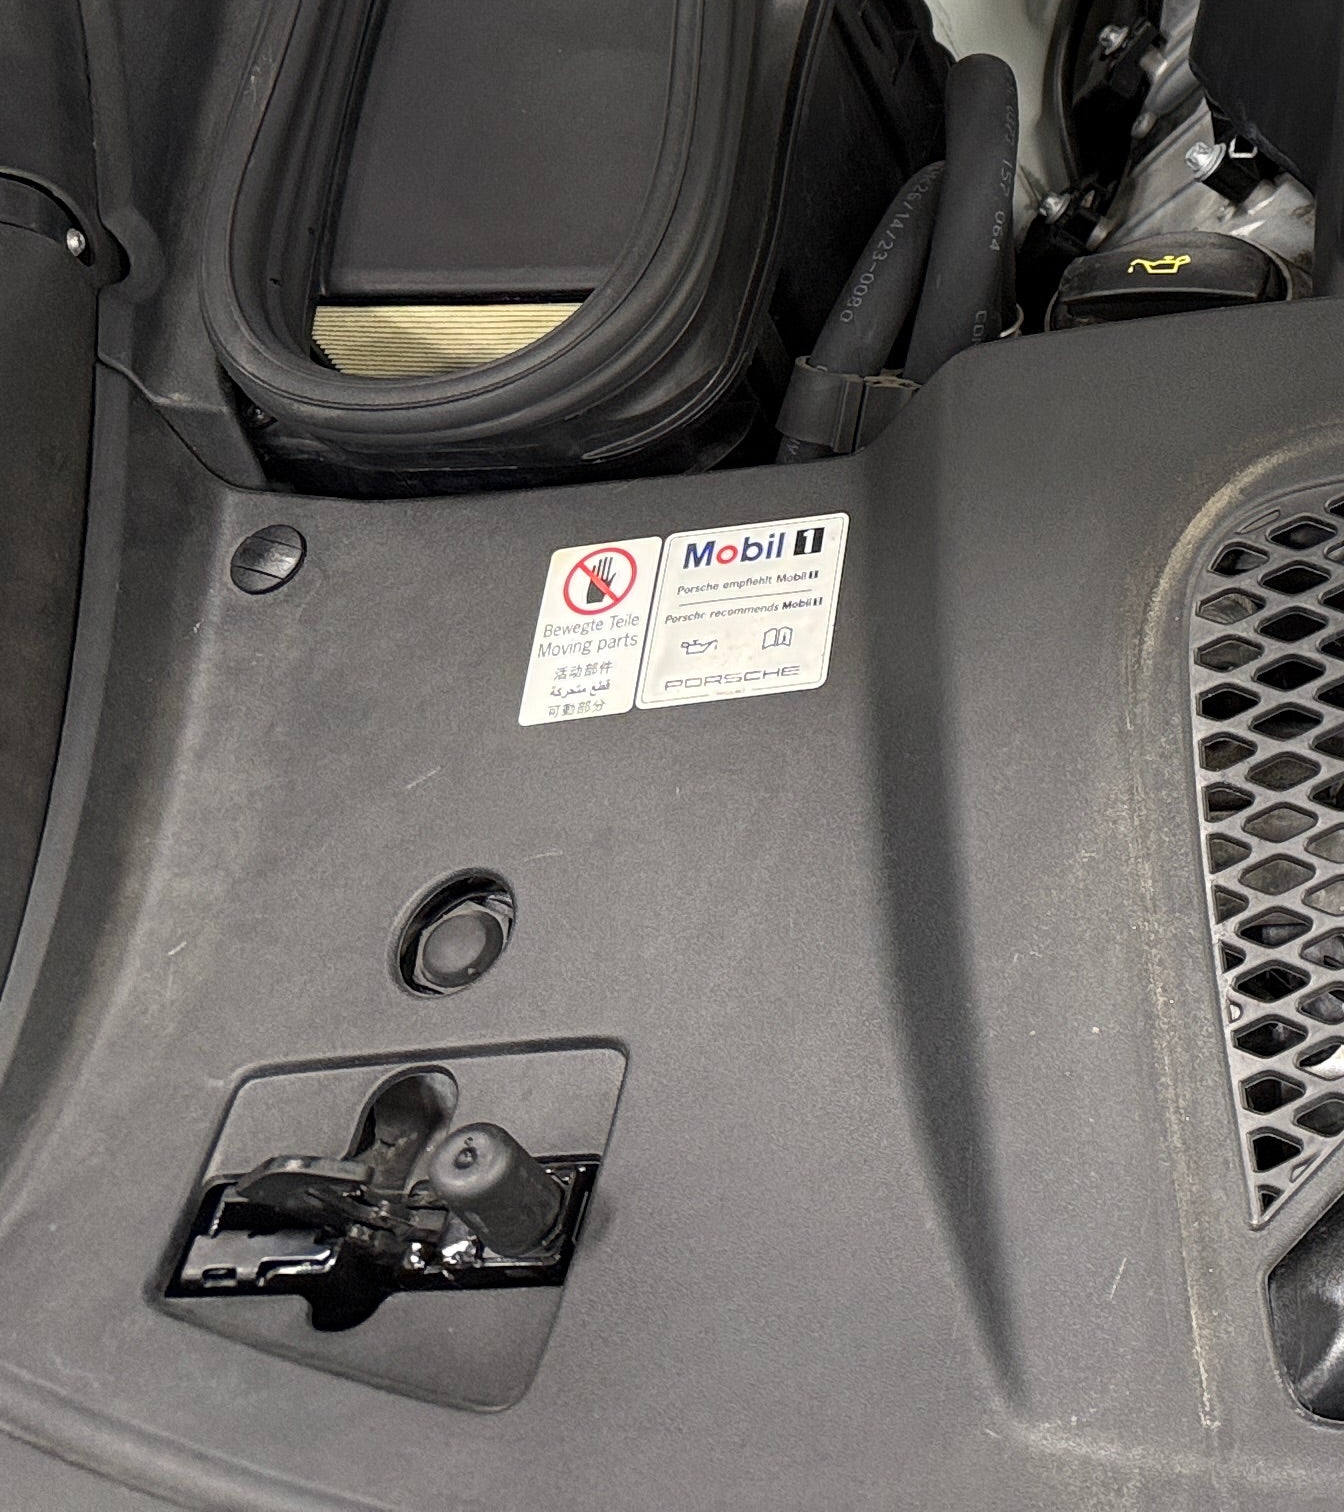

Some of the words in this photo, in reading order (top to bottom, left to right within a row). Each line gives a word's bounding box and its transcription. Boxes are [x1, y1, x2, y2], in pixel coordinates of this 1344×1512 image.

[683, 532, 786, 569] Mobil
[677, 583, 719, 595] Porsche
[723, 576, 773, 590] empfiehlt
[777, 571, 807, 583] Mobil
[709, 603, 779, 618] recommends
[782, 598, 812, 610] Mobil
[543, 619, 603, 638] Bewegte
[609, 614, 640, 630] Teile
[538, 640, 593, 658] Moving
[597, 633, 638, 653] parts
[665, 665, 800, 691] PORSCHE
